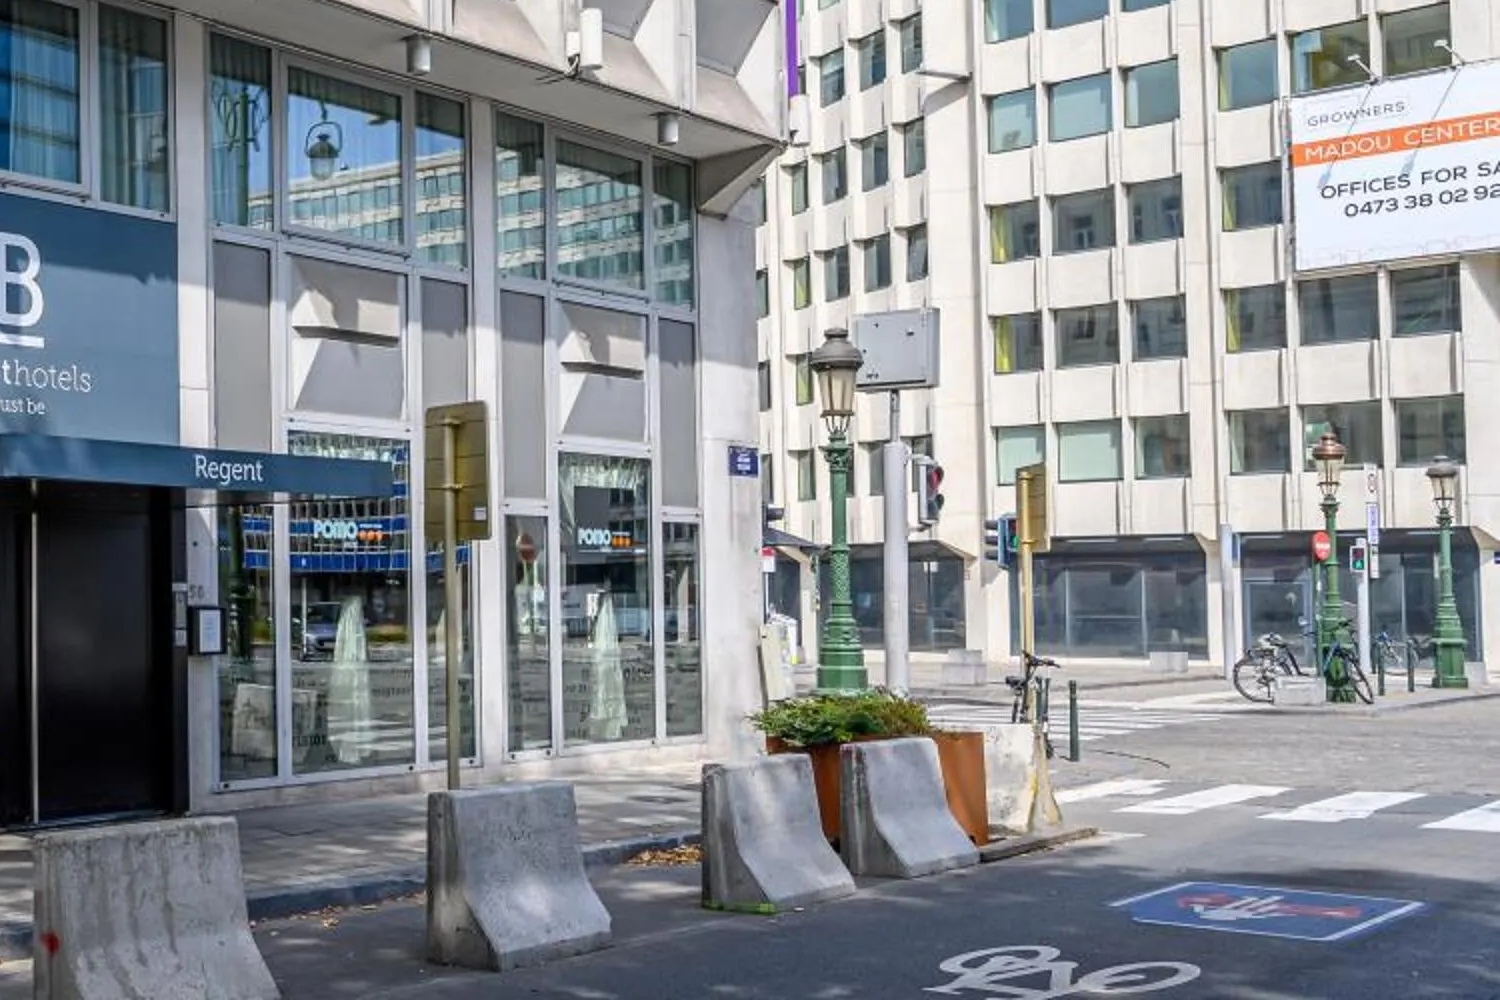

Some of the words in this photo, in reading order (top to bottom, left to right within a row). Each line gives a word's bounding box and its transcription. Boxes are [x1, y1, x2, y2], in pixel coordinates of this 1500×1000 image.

[1307, 101, 1406, 127] GROWNERS
[1305, 136, 1391, 161] MADOU
[1320, 173, 1411, 199] OFFICES
[1421, 165, 1467, 183] FOR
[1344, 199, 1399, 217] 0473
[1404, 193, 1433, 209] 38
[1438, 188, 1468, 205] 02
[27, 397, 45, 415] be
[195, 453, 264, 486] Regent
